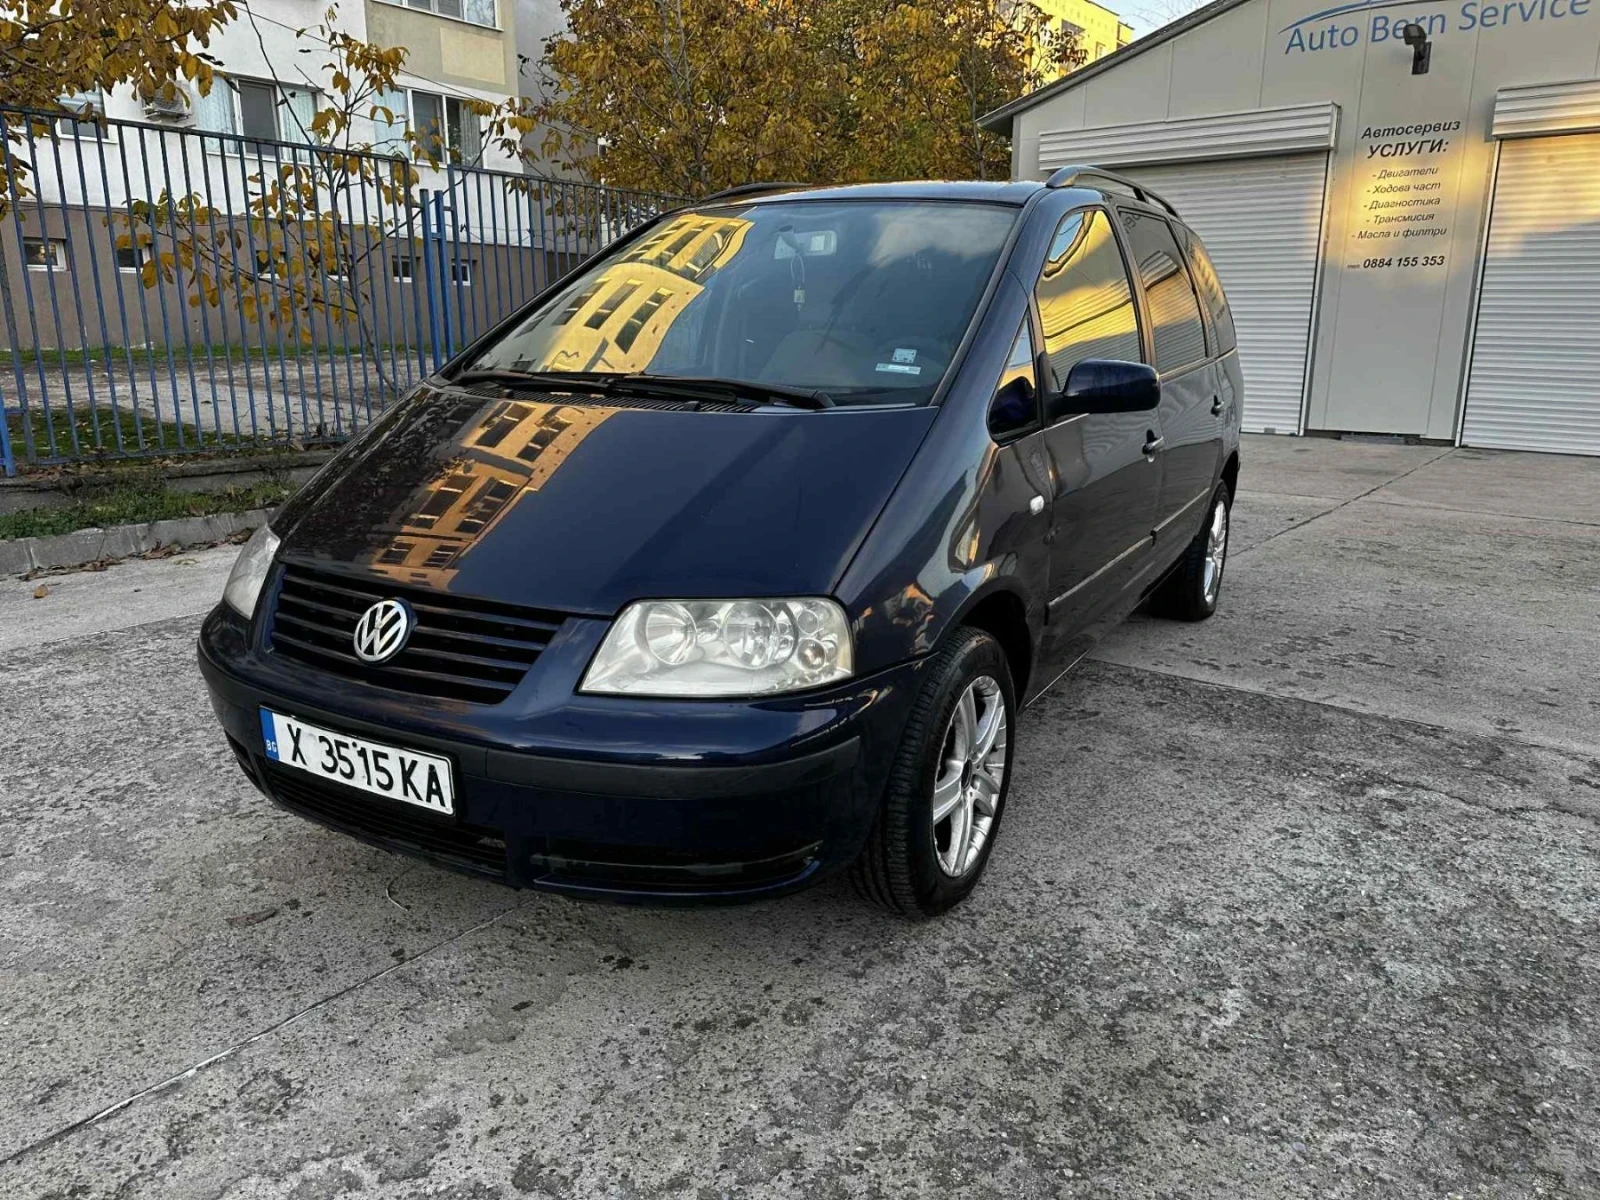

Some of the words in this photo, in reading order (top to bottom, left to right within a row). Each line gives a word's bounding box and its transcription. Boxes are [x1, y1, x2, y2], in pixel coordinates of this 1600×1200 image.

[1284, 27, 1359, 54] Auto
[1458, 0, 1590, 30] Service
[1361, 120, 1461, 139] Автосервиз
[1367, 138, 1449, 159] УСЛУГИ:
[1377, 166, 1439, 180] Двигатели
[1372, 183, 1410, 194] Ходова
[1413, 182, 1441, 192] част
[1368, 197, 1441, 211] Диагностика
[1373, 213, 1435, 225] Трансмисия
[1357, 230, 1391, 240] Масла
[1402, 227, 1447, 239] филтри
[1363, 257, 1393, 269] 0884
[1396, 256, 1419, 267] 155
[1421, 255, 1445, 266] 353
[266, 738, 277, 753] BG
[318, 735, 394, 792] 3515
